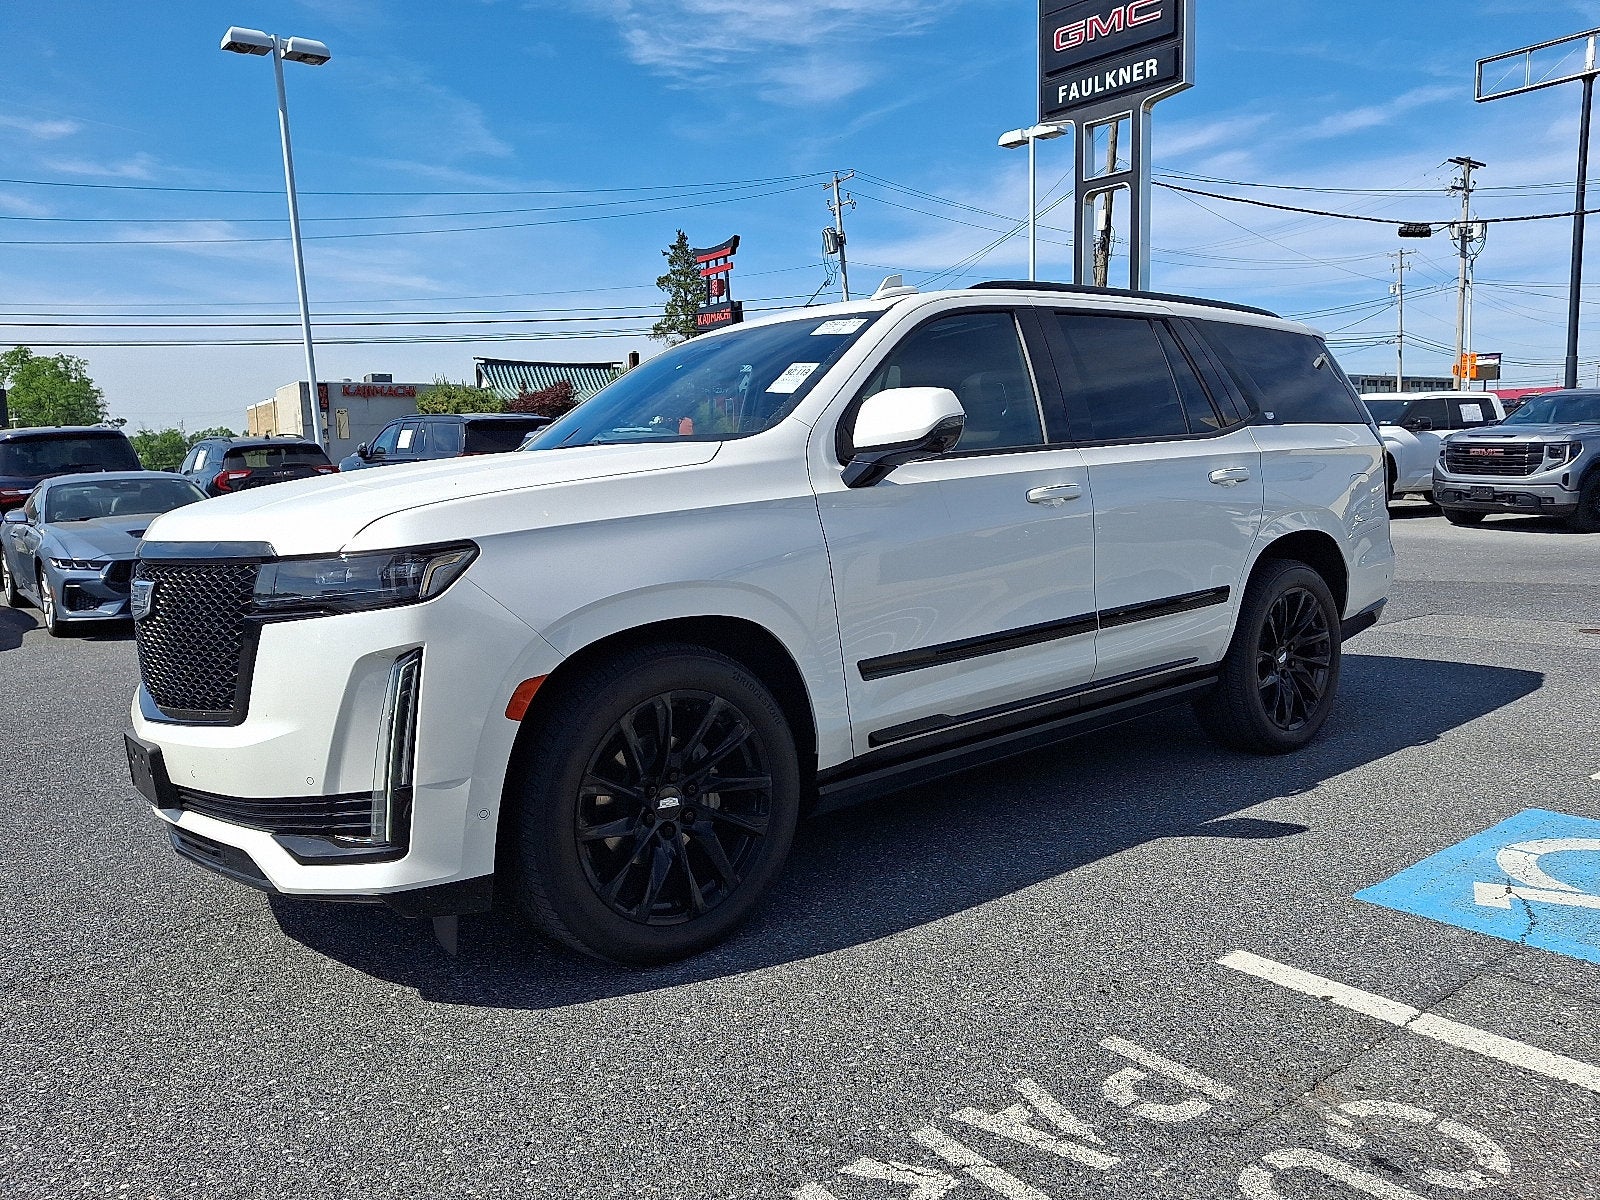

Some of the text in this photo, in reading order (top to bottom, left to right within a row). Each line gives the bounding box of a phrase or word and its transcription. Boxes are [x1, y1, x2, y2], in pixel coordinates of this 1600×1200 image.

[1053, 0, 1163, 51] GMC
[1058, 58, 1159, 104] FAULKNER
[341, 385, 417, 398] KAJIMACHI
